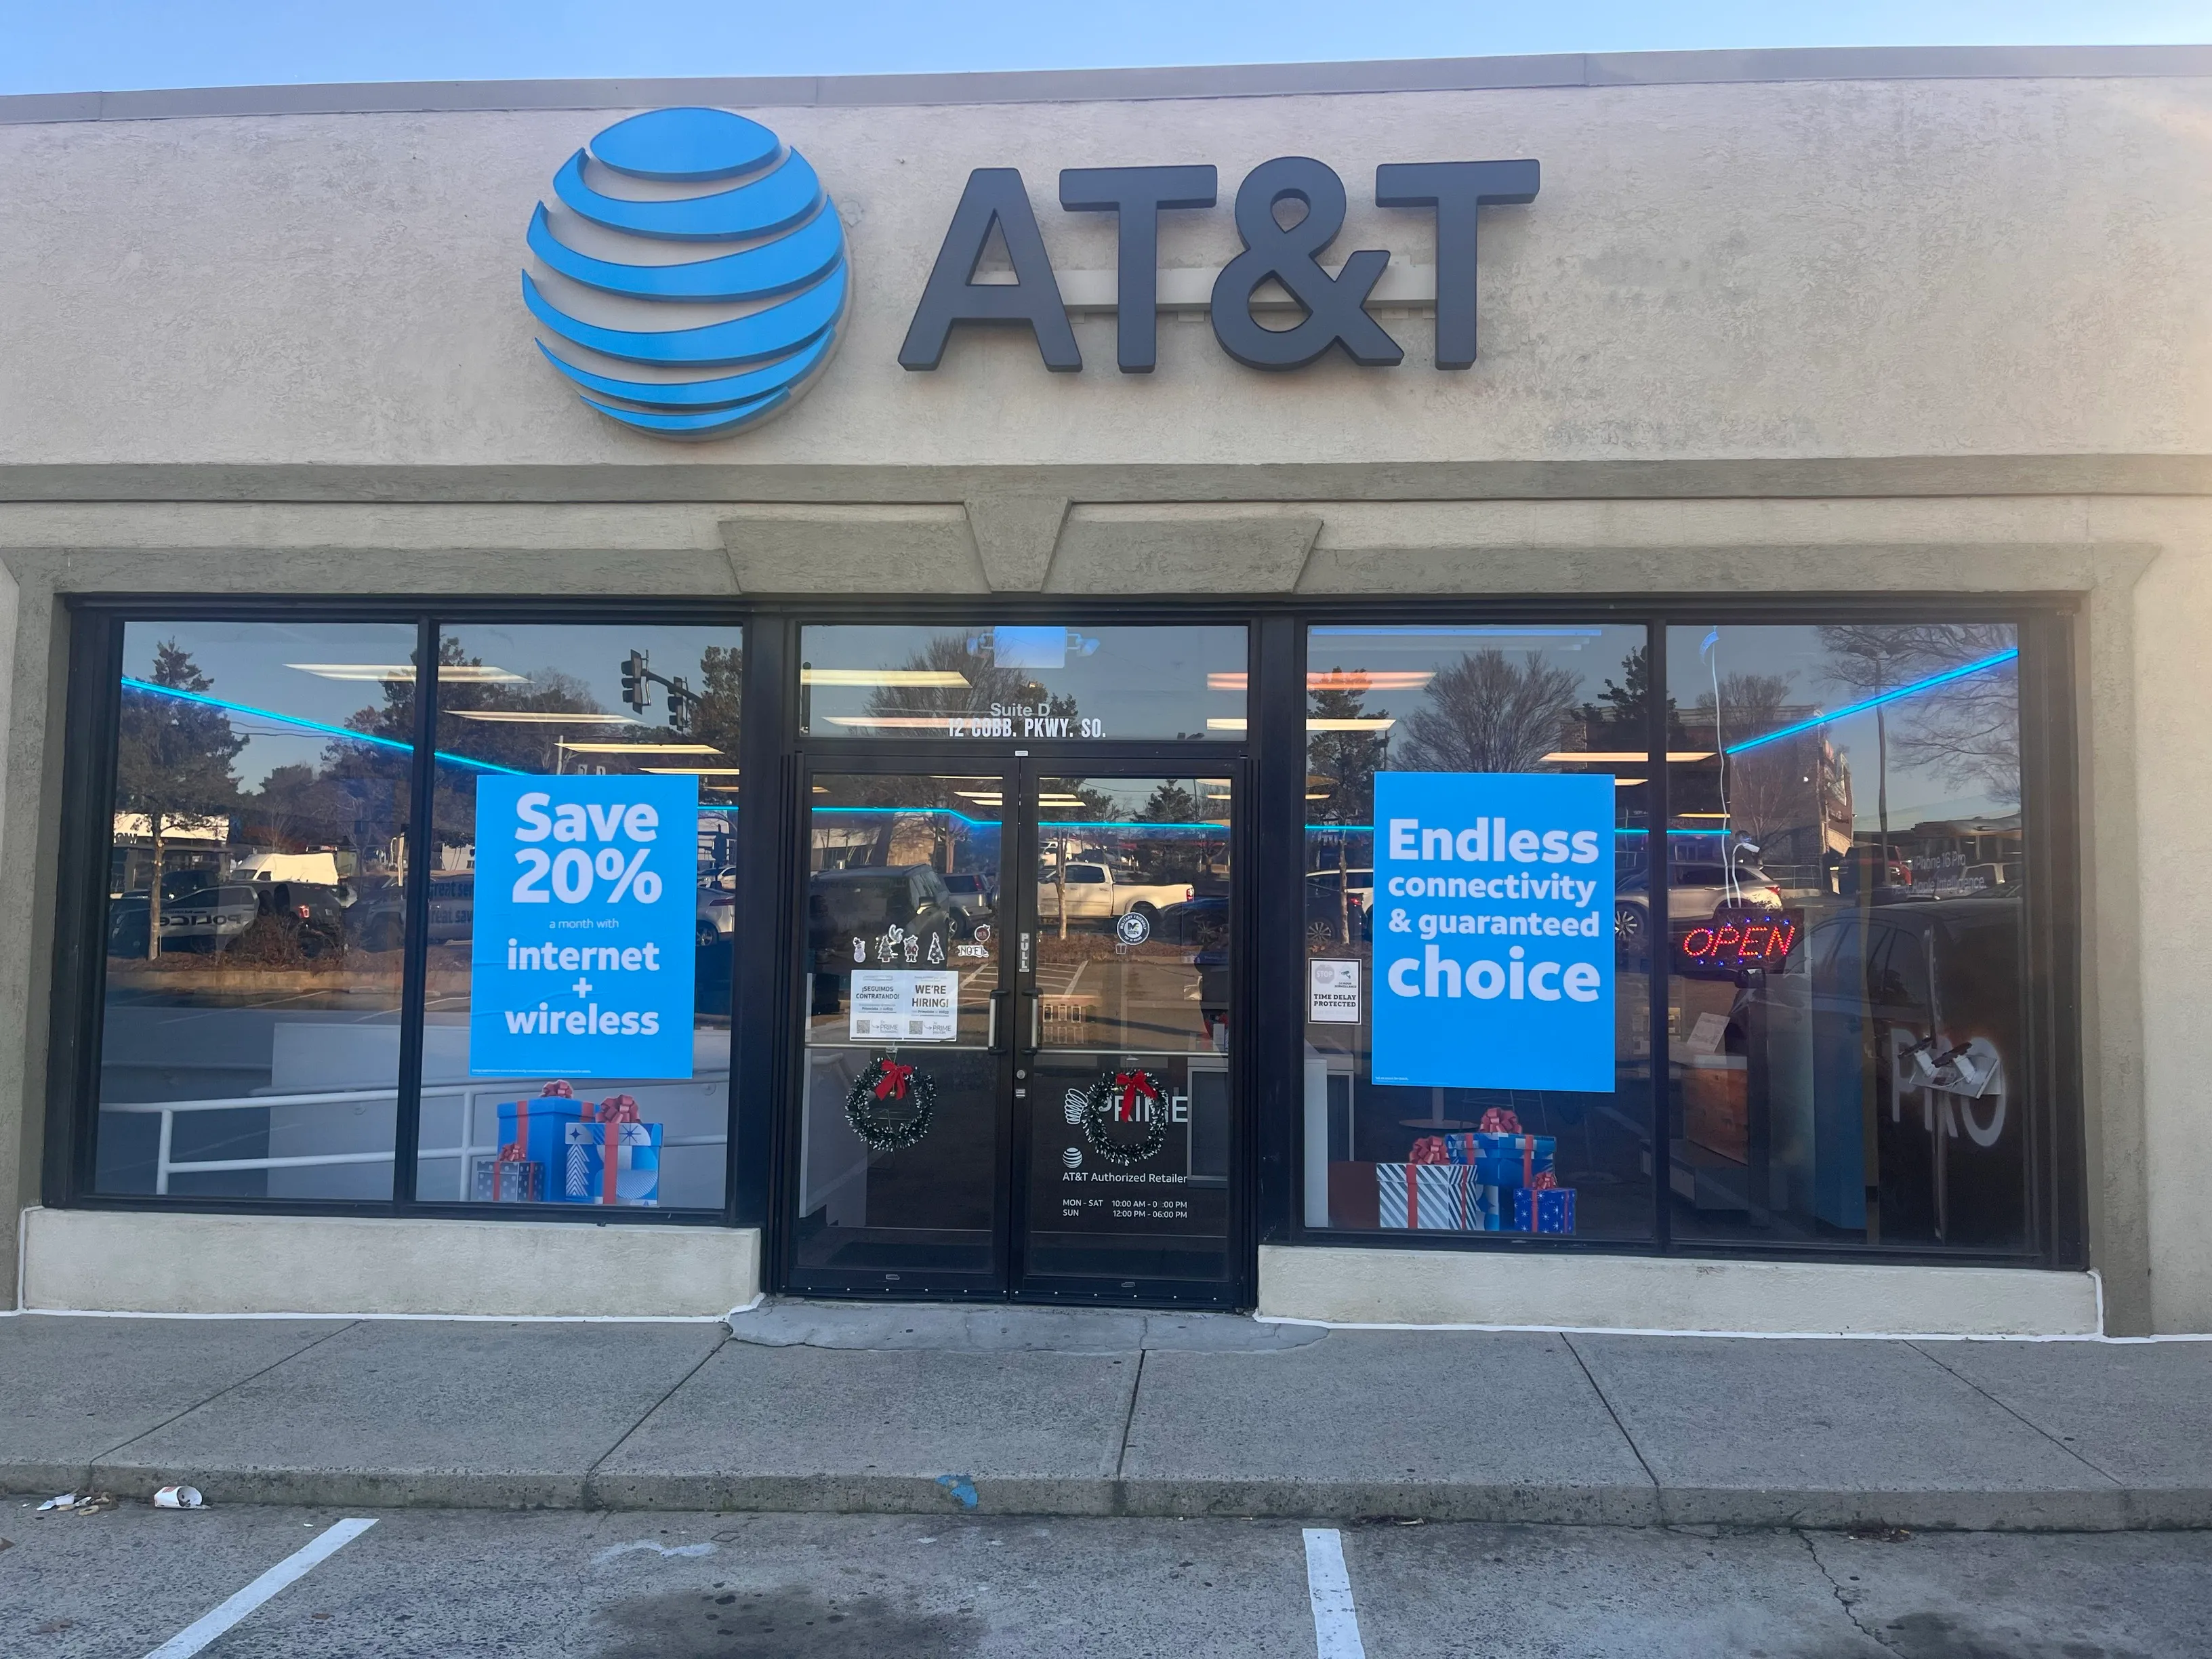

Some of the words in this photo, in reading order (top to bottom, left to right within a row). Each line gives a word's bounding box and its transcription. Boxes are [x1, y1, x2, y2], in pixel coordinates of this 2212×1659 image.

[898, 156, 1540, 374] AT&T
[989, 703, 1033, 717] Suite
[1038, 703, 1050, 717] D
[949, 718, 964, 737] 12
[971, 718, 1017, 737] COBB.
[1024, 718, 1073, 737] PKWY.
[1081, 718, 1106, 738] SO.
[514, 792, 659, 842] Save
[1389, 817, 1599, 864] Endless
[1952, 851, 1966, 867] Pro
[512, 848, 663, 904] 20%
[1388, 872, 1597, 908] connectivity
[549, 921, 556, 929] a
[558, 918, 594, 929] month
[596, 918, 619, 928] with
[1388, 908, 1412, 933] &
[1418, 911, 1599, 940] guaranteed
[508, 938, 660, 971] internet
[1021, 933, 1029, 969] PULL
[1683, 926, 1796, 957] OPEN
[572, 977, 592, 998] +
[1316, 970, 1333, 978] STOP
[1387, 943, 1601, 1002] choice
[912, 998, 949, 1008] HIRING!
[915, 985, 947, 994] WE'RE
[504, 1002, 659, 1036] wireless
[1062, 1172, 1088, 1182] AT&T
[1091, 1172, 1146, 1183] Authorized
[1149, 1173, 1187, 1183] Retailer
